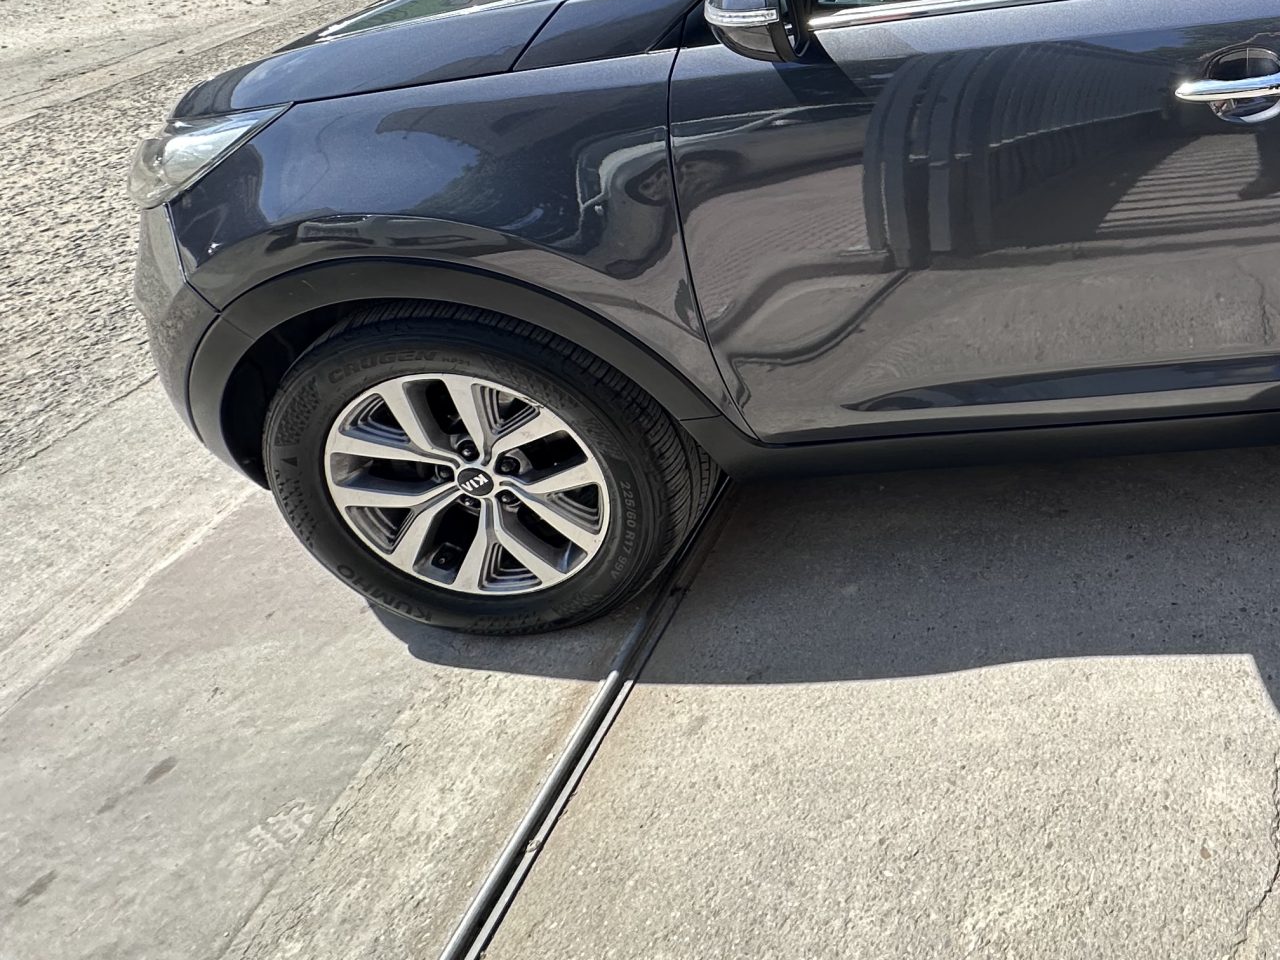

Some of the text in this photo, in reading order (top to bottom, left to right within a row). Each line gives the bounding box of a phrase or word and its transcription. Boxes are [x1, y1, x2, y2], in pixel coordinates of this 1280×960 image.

[327, 349, 439, 385] CRUGEN
[461, 473, 489, 492] KIA
[609, 481, 637, 583] 225/60 R17 99V
[337, 564, 433, 622] KUMHO
